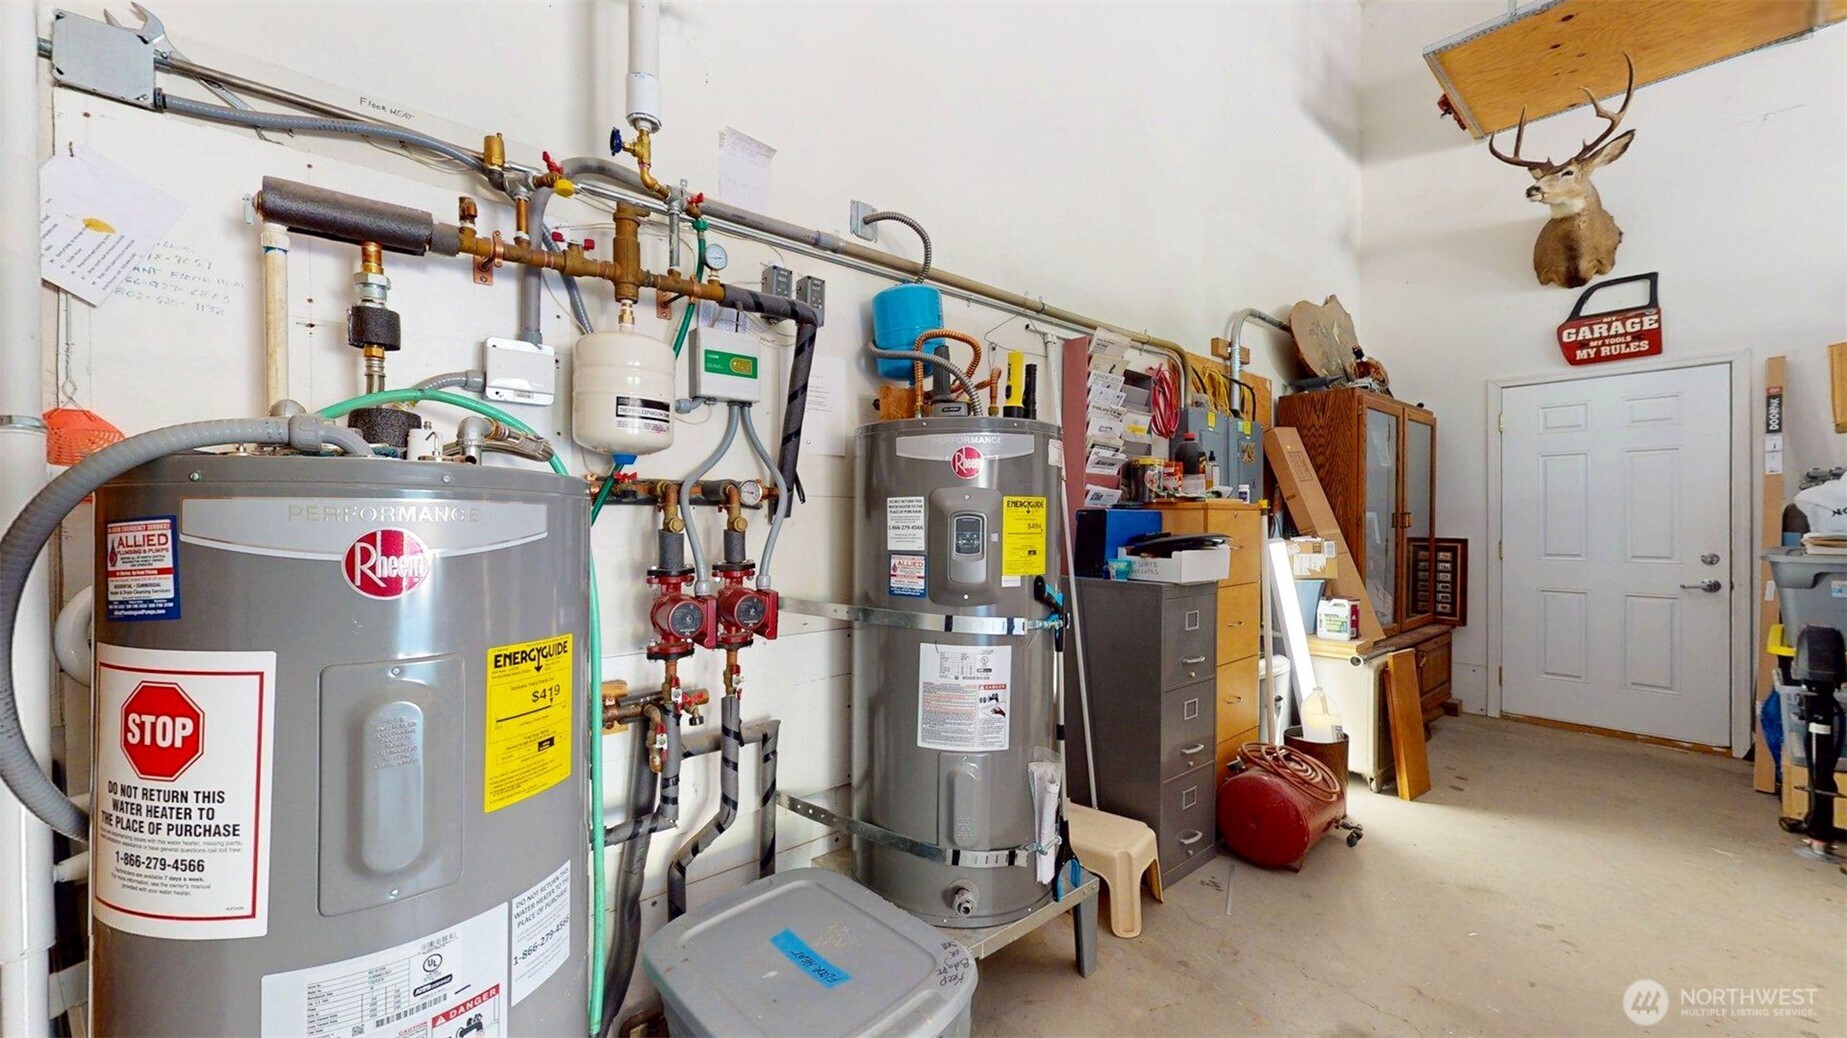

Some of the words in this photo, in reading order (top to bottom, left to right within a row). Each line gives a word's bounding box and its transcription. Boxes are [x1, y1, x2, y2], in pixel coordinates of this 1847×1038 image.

[1562, 315, 1659, 342] GARAGE
[1575, 347, 1597, 360] MY
[1600, 340, 1650, 357] RULES
[1589, 340, 1603, 348] MY
[1604, 335, 1632, 345] TOOLS
[932, 435, 1002, 444] PERFORMANCE
[954, 446, 984, 474] Rheem
[287, 505, 481, 523] PERFORMANCE
[1006, 500, 1044, 509] ENERGYGUIDE
[117, 533, 169, 549] ALLIED
[353, 531, 426, 588] Rheem
[494, 640, 568, 669] ENERGYGUIDE
[531, 684, 561, 703] $419
[126, 711, 195, 748] STOP
[107, 780, 118, 795] DO
[120, 783, 138, 799] NOT
[141, 787, 189, 804] RETURN
[194, 790, 226, 804] THIS
[111, 798, 142, 817] WATER
[145, 805, 192, 821] HEATER
[197, 807, 215, 821] TO
[101, 810, 113, 826] THE
[115, 815, 144, 834] PLACE
[148, 821, 163, 835] OF
[166, 823, 241, 838] PURCHASE
[115, 850, 205, 873] 1-866-279-4566
[513, 902, 535, 920] WATER
[536, 887, 556, 906] HEATER
[516, 898, 526, 909] DO
[527, 890, 540, 903] NOT
[540, 875, 560, 894] RETURN
[516, 912, 536, 928] PLACE
[536, 905, 544, 918] OF
[513, 913, 571, 967] 1-866-279-4566
[427, 958, 438, 968] UL
[448, 987, 497, 1019] DANGER
